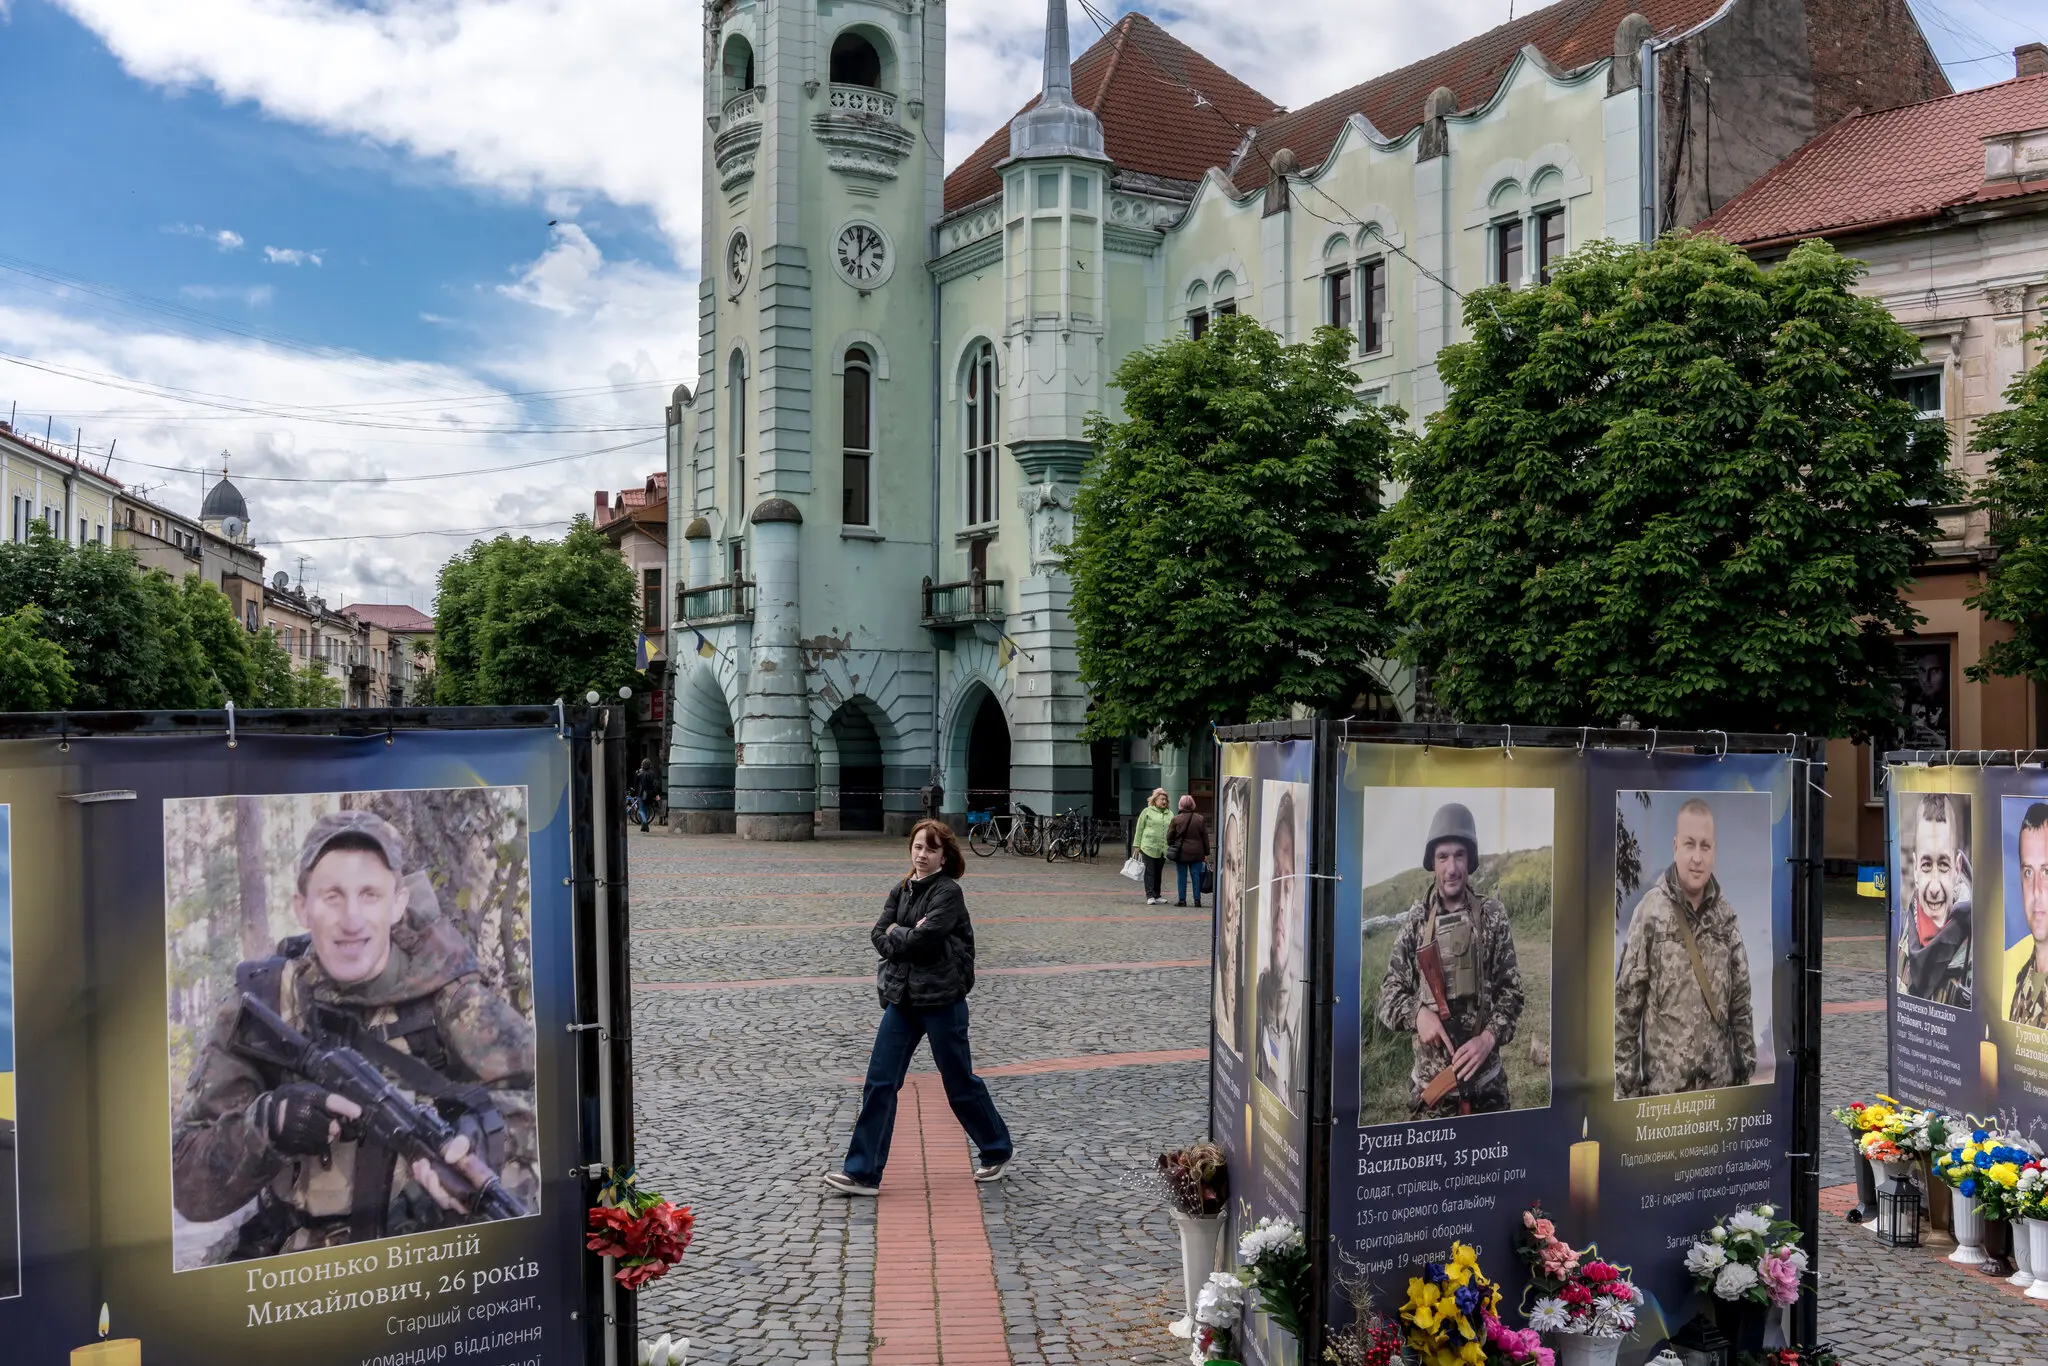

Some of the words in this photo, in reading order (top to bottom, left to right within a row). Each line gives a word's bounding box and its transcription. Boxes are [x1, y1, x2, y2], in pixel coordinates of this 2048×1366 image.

[1930, 1023, 1948, 1036] років
[1636, 1101, 1671, 1121] Літун
[1673, 1095, 1717, 1116] Андрій
[1358, 1133, 1403, 1155] Русин
[1406, 1127, 1457, 1146] Василь
[1635, 1119, 1724, 1142] Миколайович,
[1726, 1116, 1739, 1132] 37
[1740, 1109, 1773, 1132] років
[1357, 1153, 1448, 1176] Васильович,
[1453, 1149, 1468, 1166] 35
[1471, 1141, 1509, 1166] років
[1620, 1152, 1678, 1168] Підполковник,
[1679, 1143, 1719, 1160] командир
[1721, 1139, 1738, 1153] 1-го
[1740, 1136, 1772, 1152] гірсько-
[1356, 1185, 1394, 1201] Солдат,
[1397, 1179, 1442, 1198] стрілець,
[1444, 1168, 1500, 1191] стрілецької
[1503, 1168, 1527, 1184] роти
[1674, 1164, 1723, 1183] штурмового
[1725, 1157, 1773, 1175] батальйону,
[1662, 1187, 1695, 1207] окремої
[1697, 1176, 1772, 1201] гірсько-штурмової
[1356, 1211, 1389, 1226] 135-го
[1391, 1203, 1439, 1223] окремого
[1441, 1194, 1496, 1211] батальйону
[1355, 1227, 1429, 1253] територіальної
[1432, 1221, 1475, 1240] оборони.
[246, 1255, 379, 1294] Гопонько
[386, 1232, 481, 1269] Віталій
[1354, 1258, 1394, 1277] Загинув
[1397, 1252, 1409, 1269] 19
[1412, 1249, 1446, 1268] червня
[246, 1280, 431, 1328] Михайлович,
[438, 1269, 466, 1294] 26
[472, 1256, 540, 1295] років
[386, 1305, 461, 1335] Старший
[467, 1295, 542, 1321] сержант,
[454, 1326, 542, 1356] відділення
